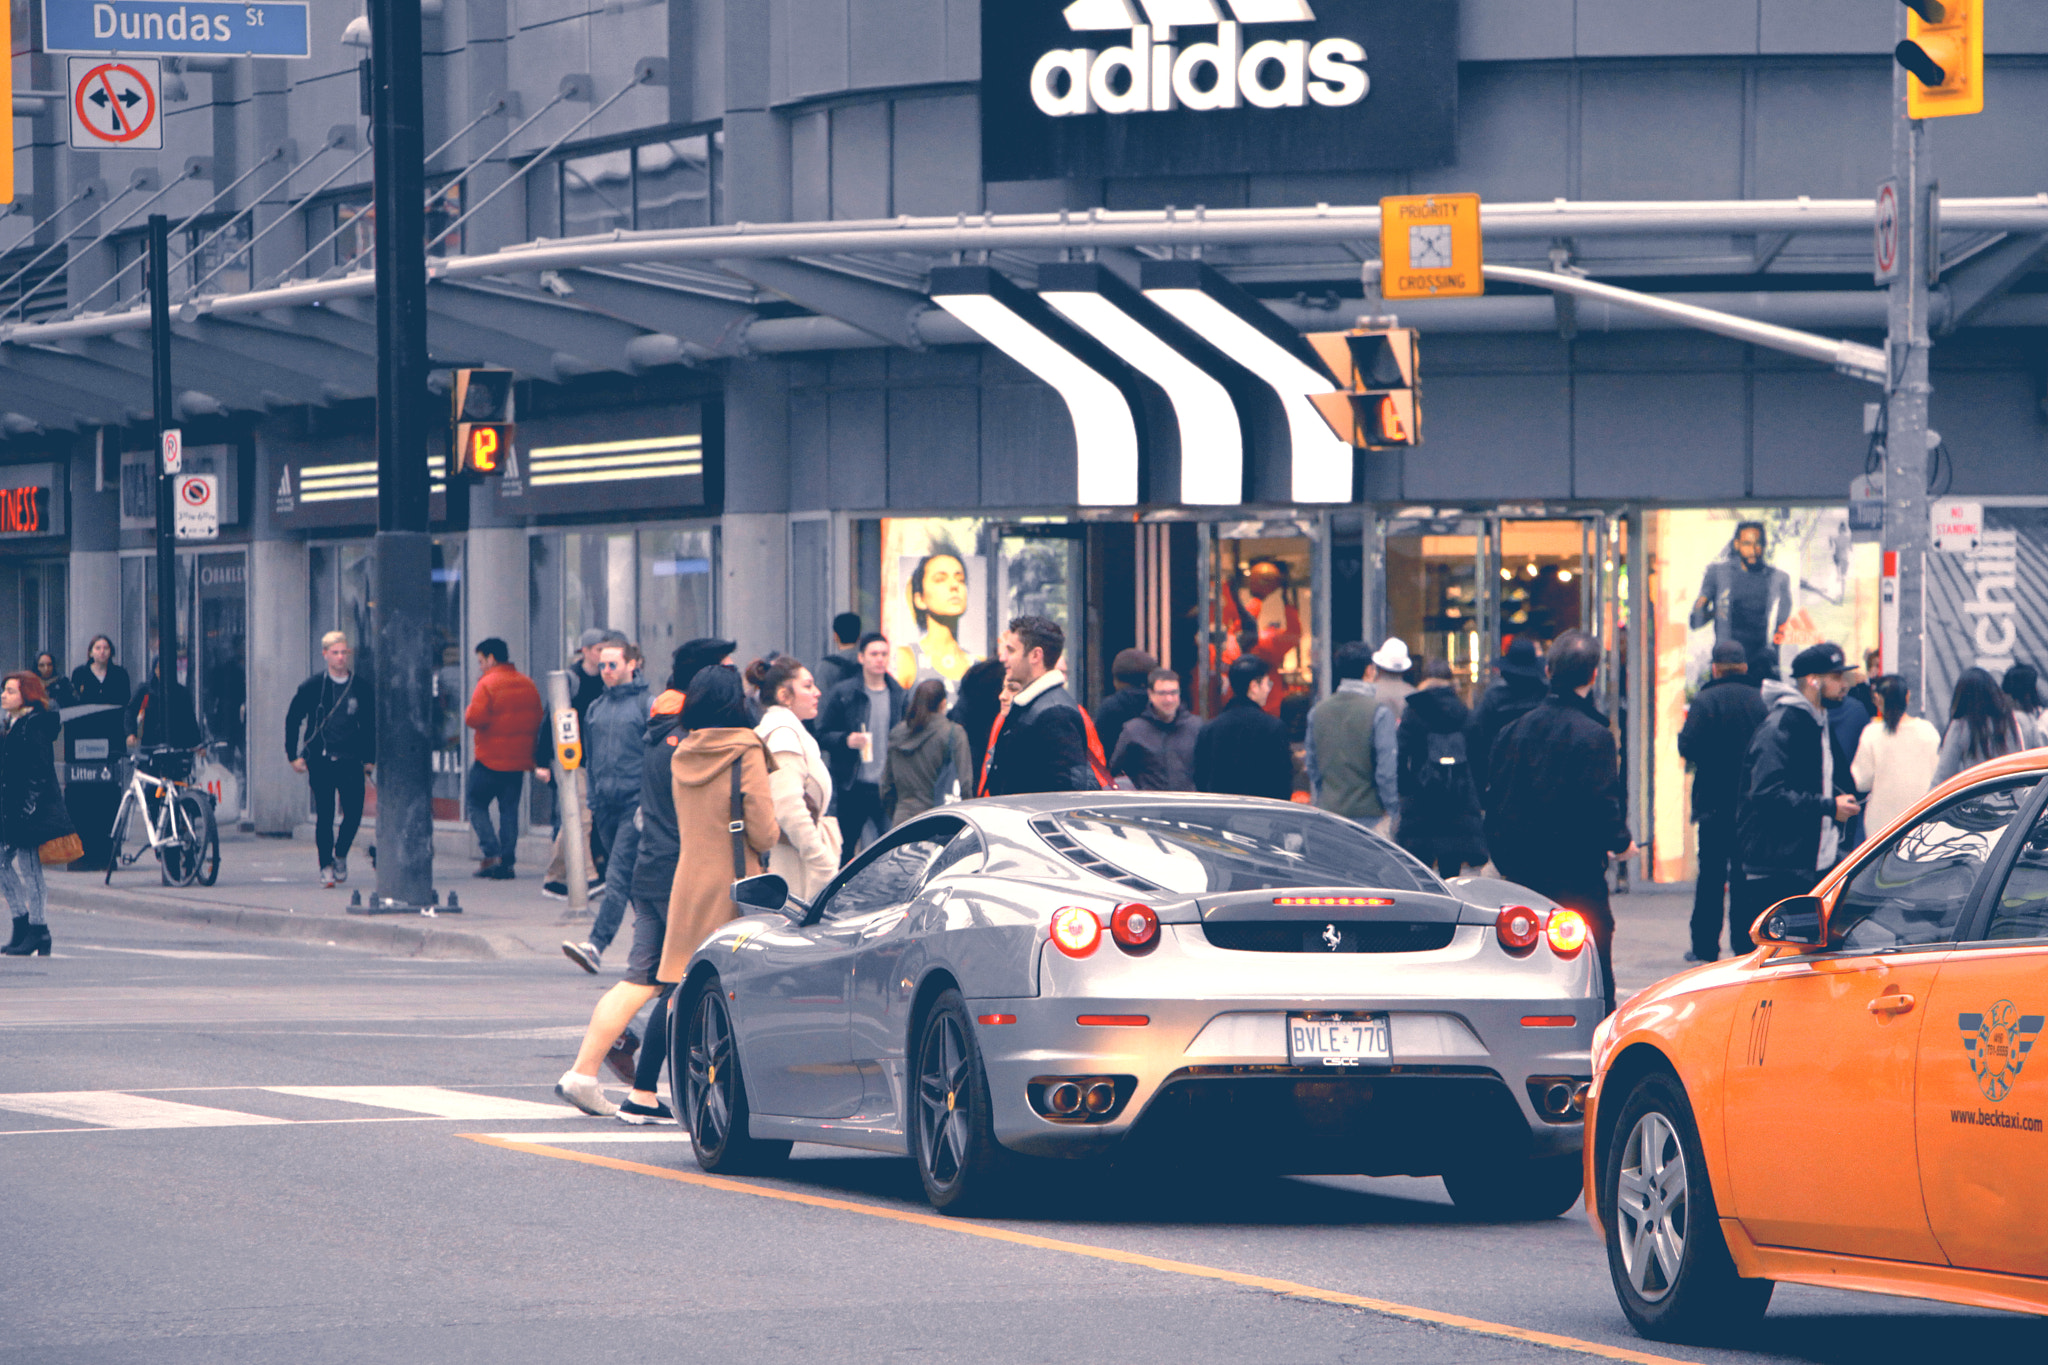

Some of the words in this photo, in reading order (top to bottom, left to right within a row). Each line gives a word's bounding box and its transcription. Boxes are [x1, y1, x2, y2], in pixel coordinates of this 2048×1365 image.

[93, 4, 231, 41] Dundas
[246, 8, 265, 26] St
[1030, 20, 1370, 117] adidas
[1400, 203, 1457, 219] PRIORITY
[1399, 274, 1466, 291] CROSSING
[473, 428, 497, 470] 12
[1951, 507, 1963, 519] NO
[1936, 523, 1978, 536] STANDING
[71, 766, 97, 781] Litter
[1980, 1004, 2019, 1045] BECK
[1294, 1027, 1340, 1052] BVLE
[1352, 1027, 1388, 1052] 770
[1978, 1061, 2016, 1099] TAXI
[1950, 1107, 2043, 1133] www.becktaxi.com
